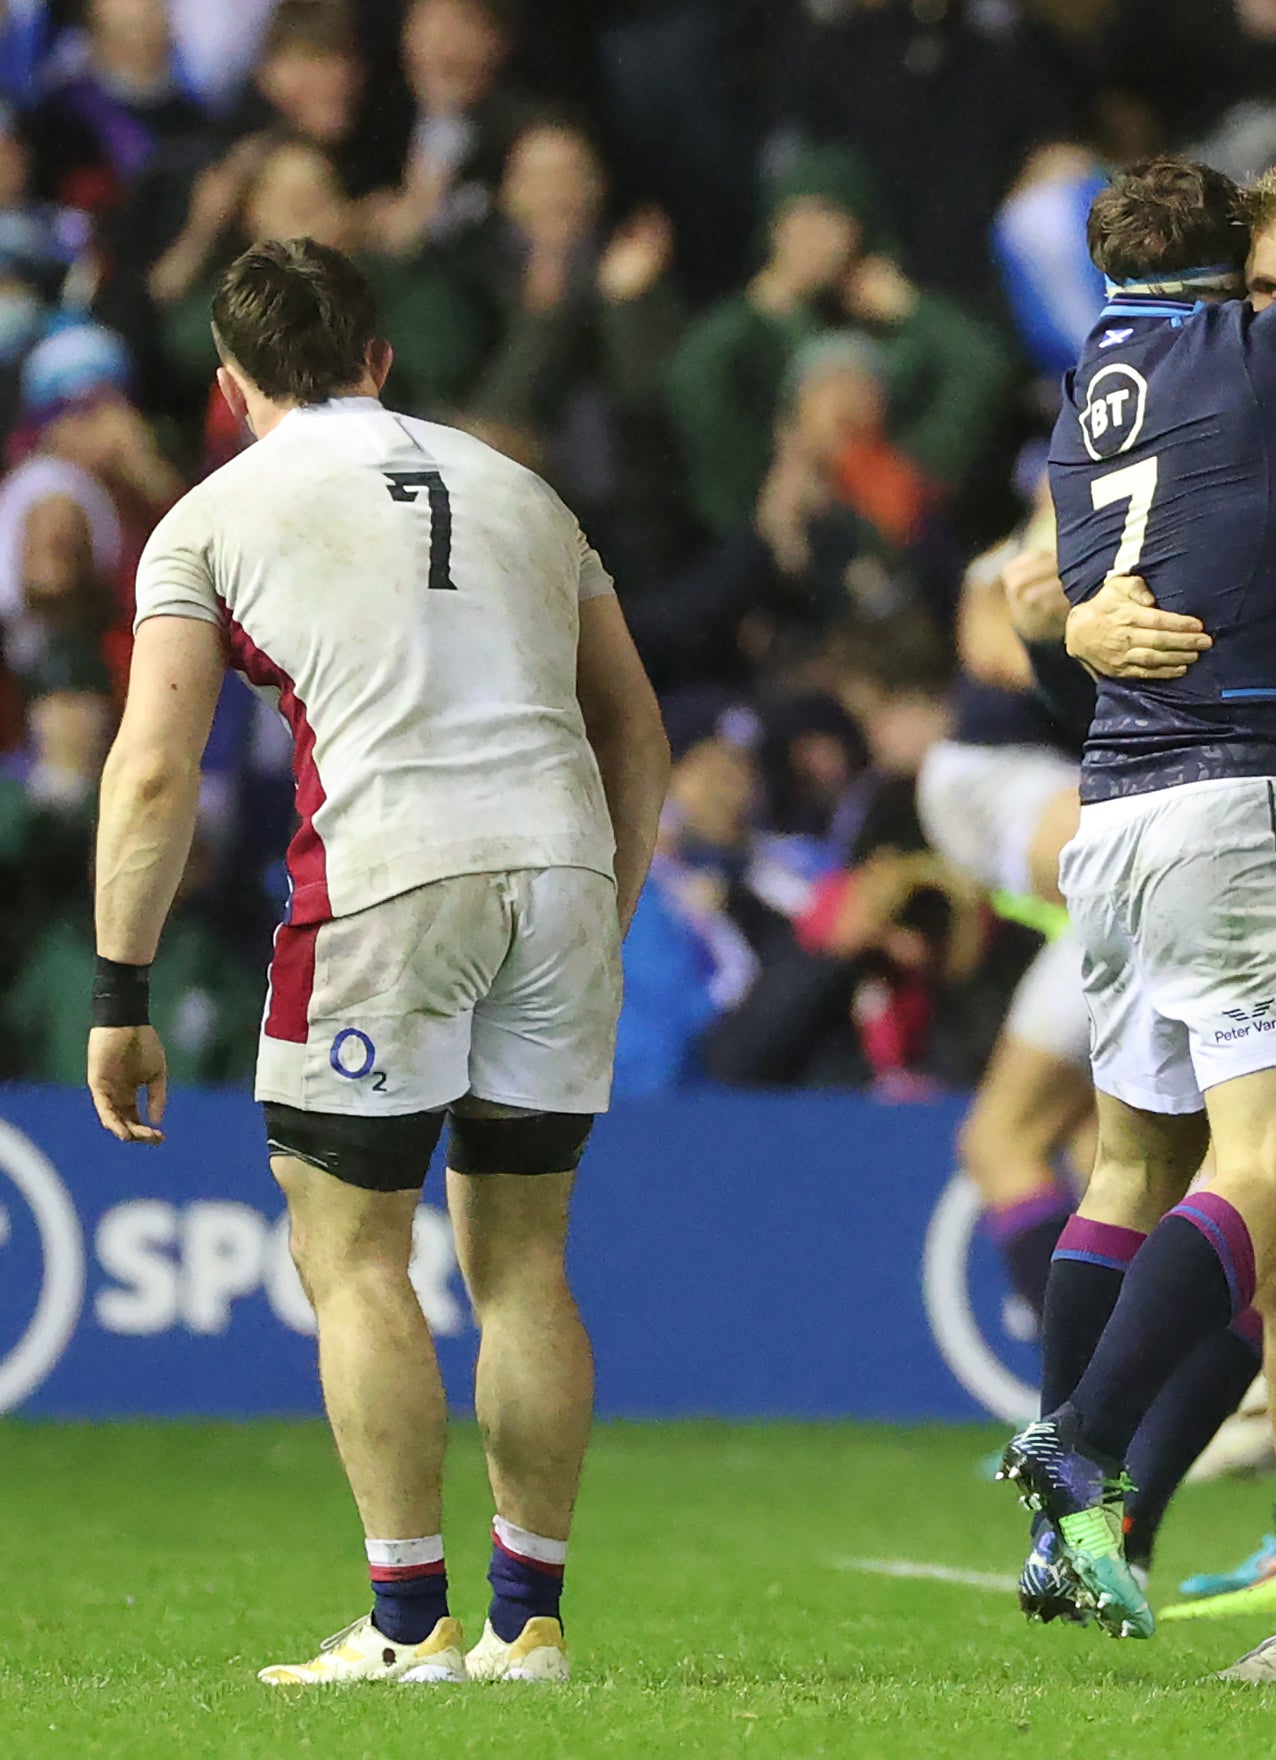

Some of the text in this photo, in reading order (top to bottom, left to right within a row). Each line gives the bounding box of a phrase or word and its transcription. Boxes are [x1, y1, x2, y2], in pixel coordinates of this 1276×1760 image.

[1091, 388, 1130, 439] BT
[382, 470, 459, 591] 7
[1091, 455, 1158, 585] 7
[1214, 1026, 1251, 1043] Peter
